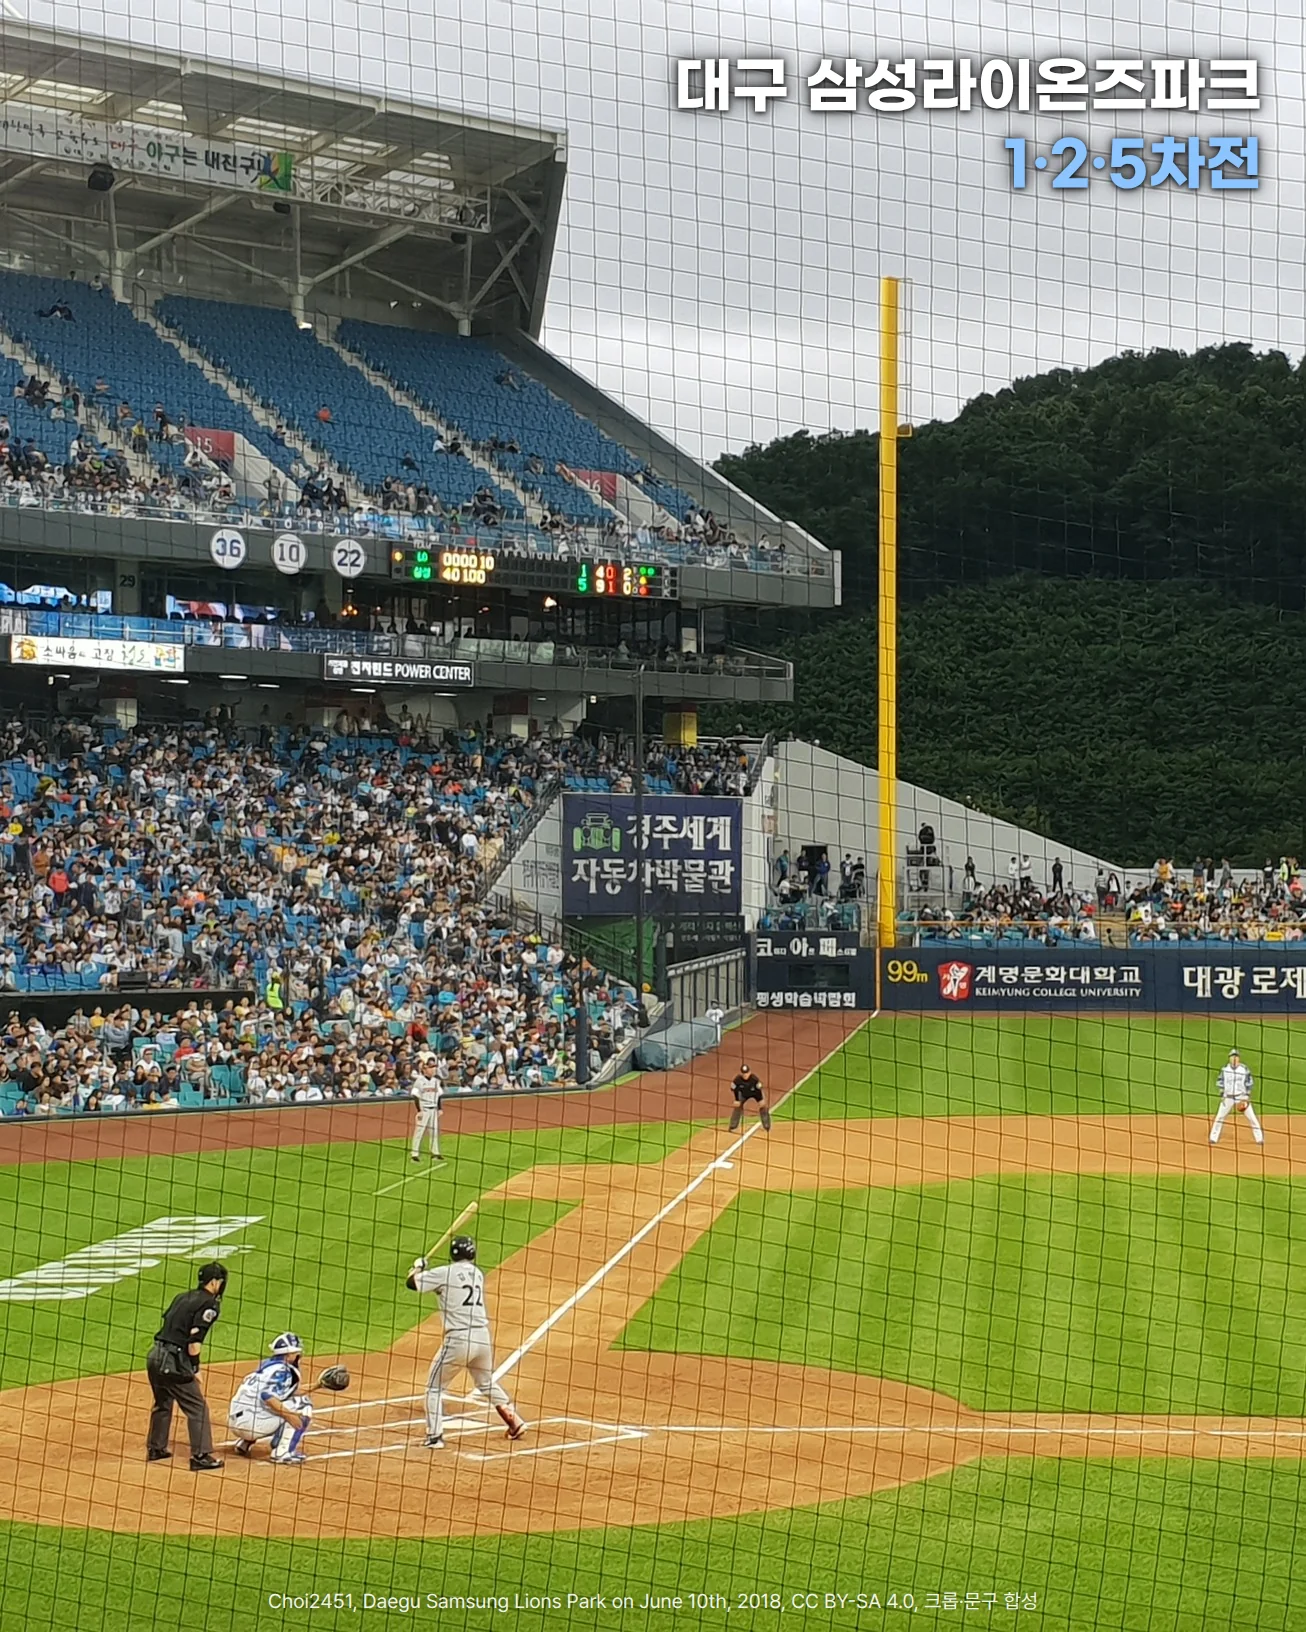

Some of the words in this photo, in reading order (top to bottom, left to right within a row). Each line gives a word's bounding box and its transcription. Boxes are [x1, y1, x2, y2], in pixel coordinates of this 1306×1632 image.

[196, 436, 213, 453] 15
[215, 537, 241, 558] 36
[277, 544, 300, 563] 10
[337, 549, 361, 567] 22
[119, 574, 136, 587] 29
[394, 663, 431, 679] POWER
[432, 665, 471, 681] CENTER
[626, 814, 732, 851] 경주세계
[571, 858, 735, 895] 자동차박물관
[887, 960, 929, 983] 99m
[975, 965, 1141, 985] 계명문화대학교
[975, 987, 1030, 997] KEIMYUNG
[1032, 988, 1077, 997] COLLEGE
[1080, 988, 1142, 997] UNIVERSITY
[1183, 966, 1246, 999] 대광
[1250, 966, 1306, 999] 로제
[756, 991, 856, 1008] 평생학습박람회
[462, 1284, 483, 1306] 22
